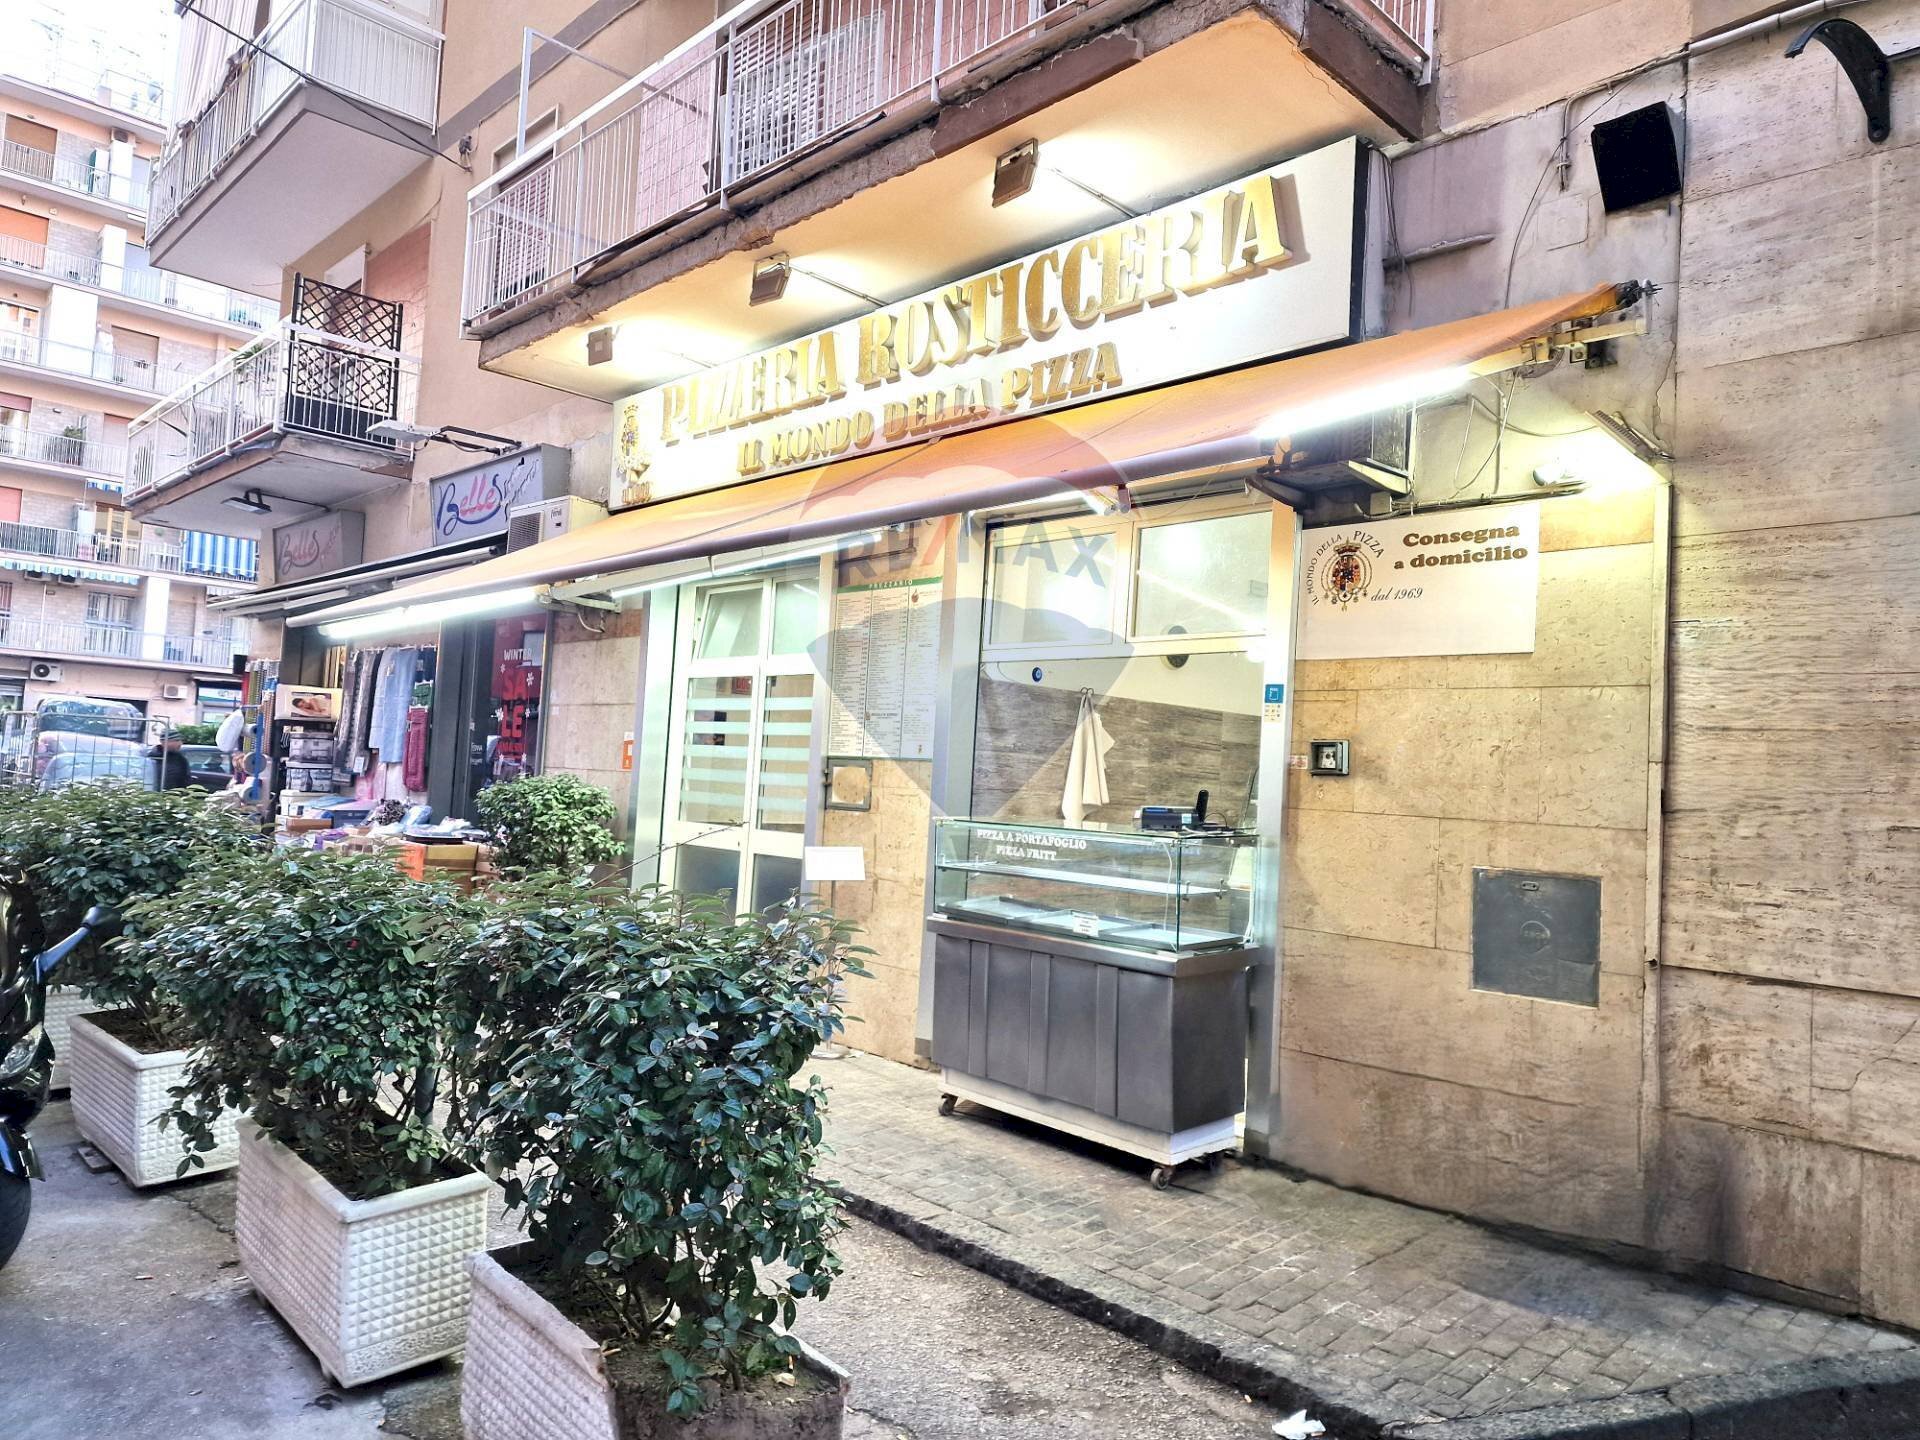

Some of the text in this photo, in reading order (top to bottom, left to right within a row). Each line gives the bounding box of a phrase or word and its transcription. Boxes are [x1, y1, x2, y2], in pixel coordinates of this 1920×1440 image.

[660, 174, 1296, 447] PIZZERIA ROSTICCERIA
[737, 342, 1123, 476] IL MONDO DELLA PIZZA
[1402, 525, 1520, 548] Consegna
[1306, 530, 1385, 607] IL MONDO DELLA PIZZA
[1394, 545, 1529, 570] a domicilio
[1371, 586, 1424, 602] dal 1969
[977, 828, 1088, 850] PIZZA A PORTAFOGLIO
